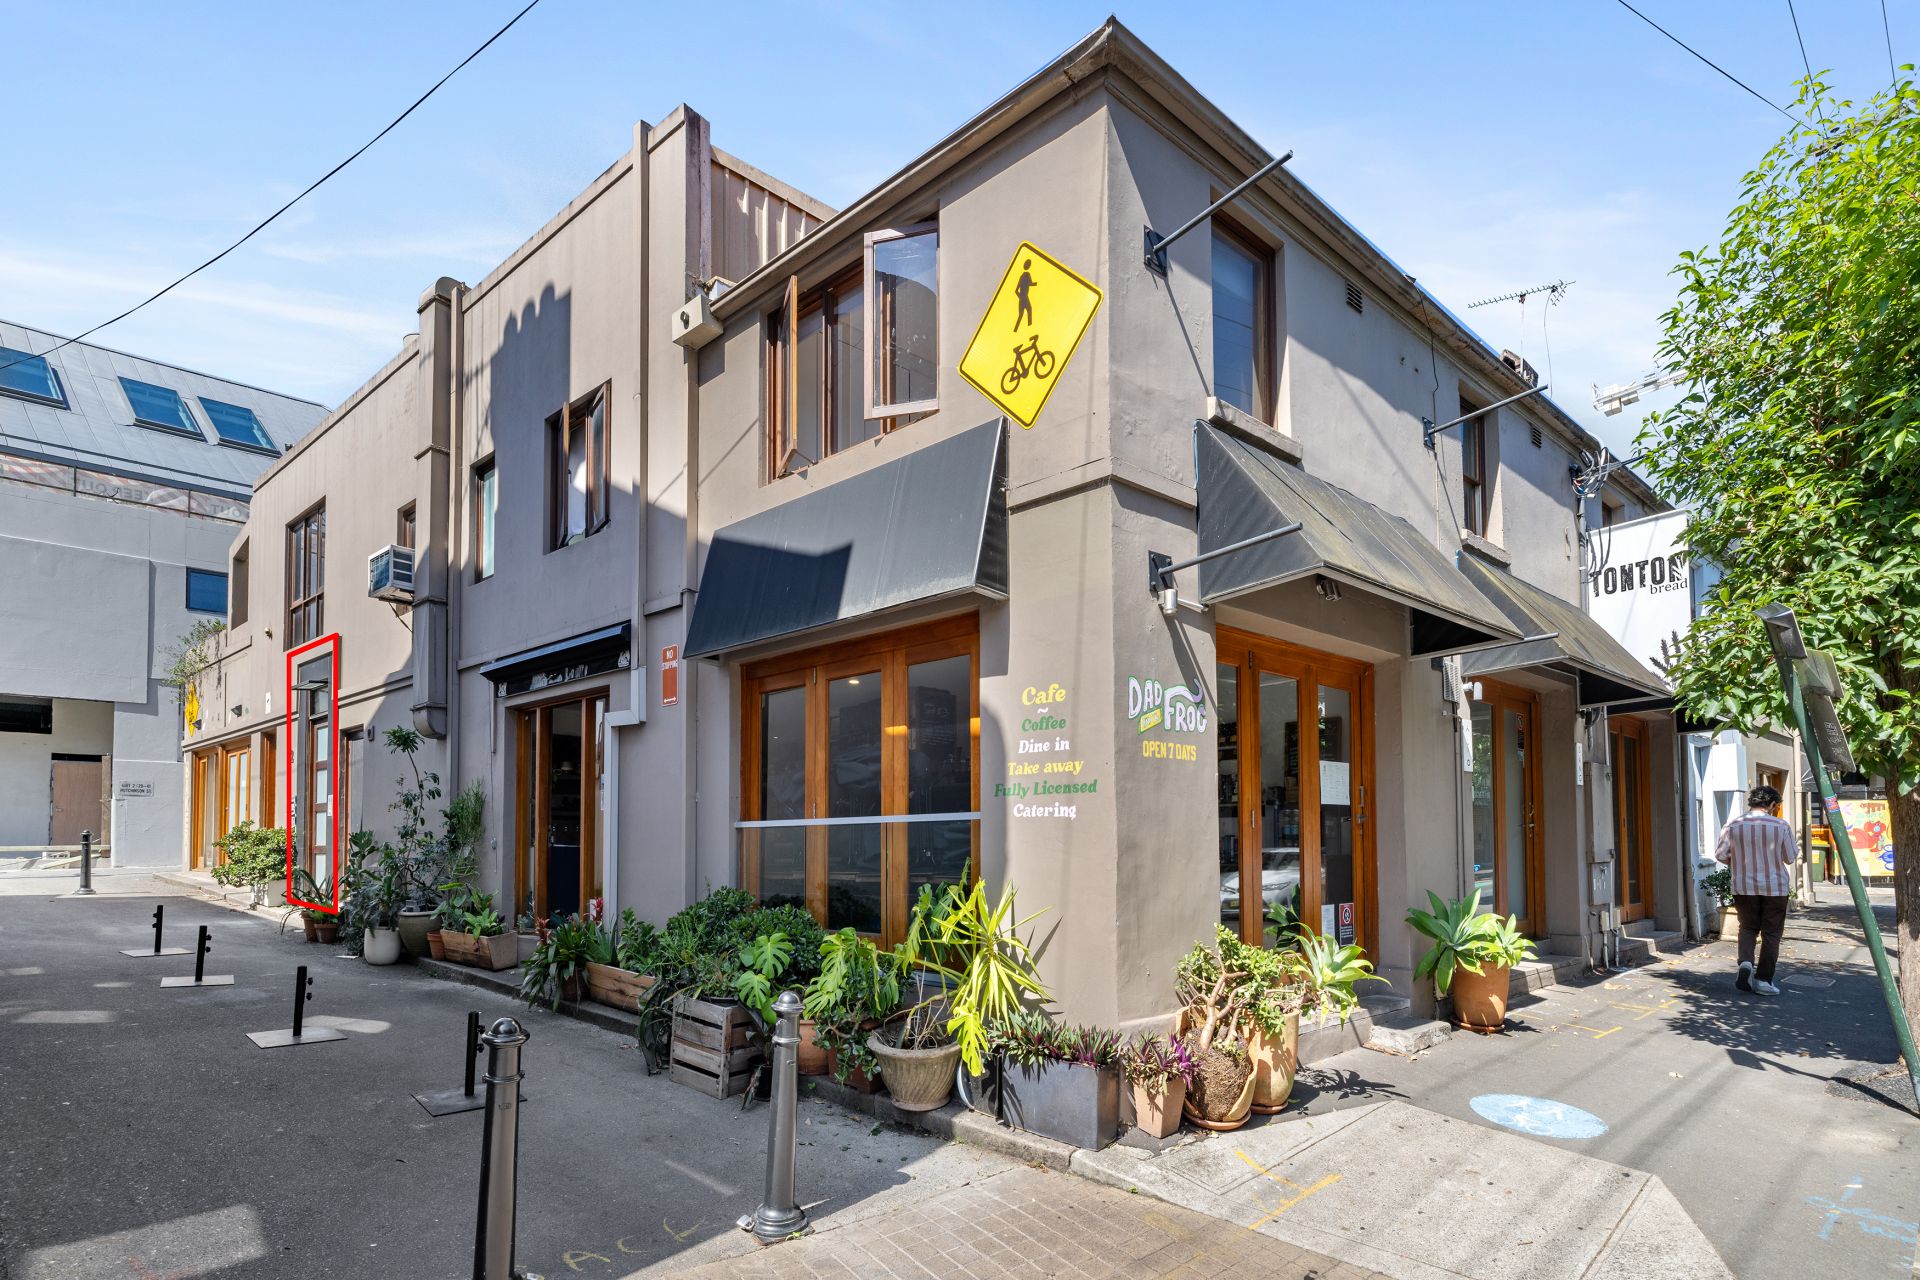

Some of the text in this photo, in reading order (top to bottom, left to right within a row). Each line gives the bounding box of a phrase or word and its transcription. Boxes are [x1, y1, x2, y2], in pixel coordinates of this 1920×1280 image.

[1590, 552, 1685, 598] TONTON
[1649, 578, 1688, 595] bread
[1021, 683, 1066, 706] Cafe
[1127, 675, 1163, 719] DAD
[1021, 716, 1067, 732] Coffee
[1018, 737, 1070, 754] Dine in
[1142, 740, 1197, 762] OPEN 7 DAYS
[1008, 760, 1084, 777] Take away
[994, 779, 1098, 798] Fully Licensed
[1013, 803, 1077, 820] Catering
